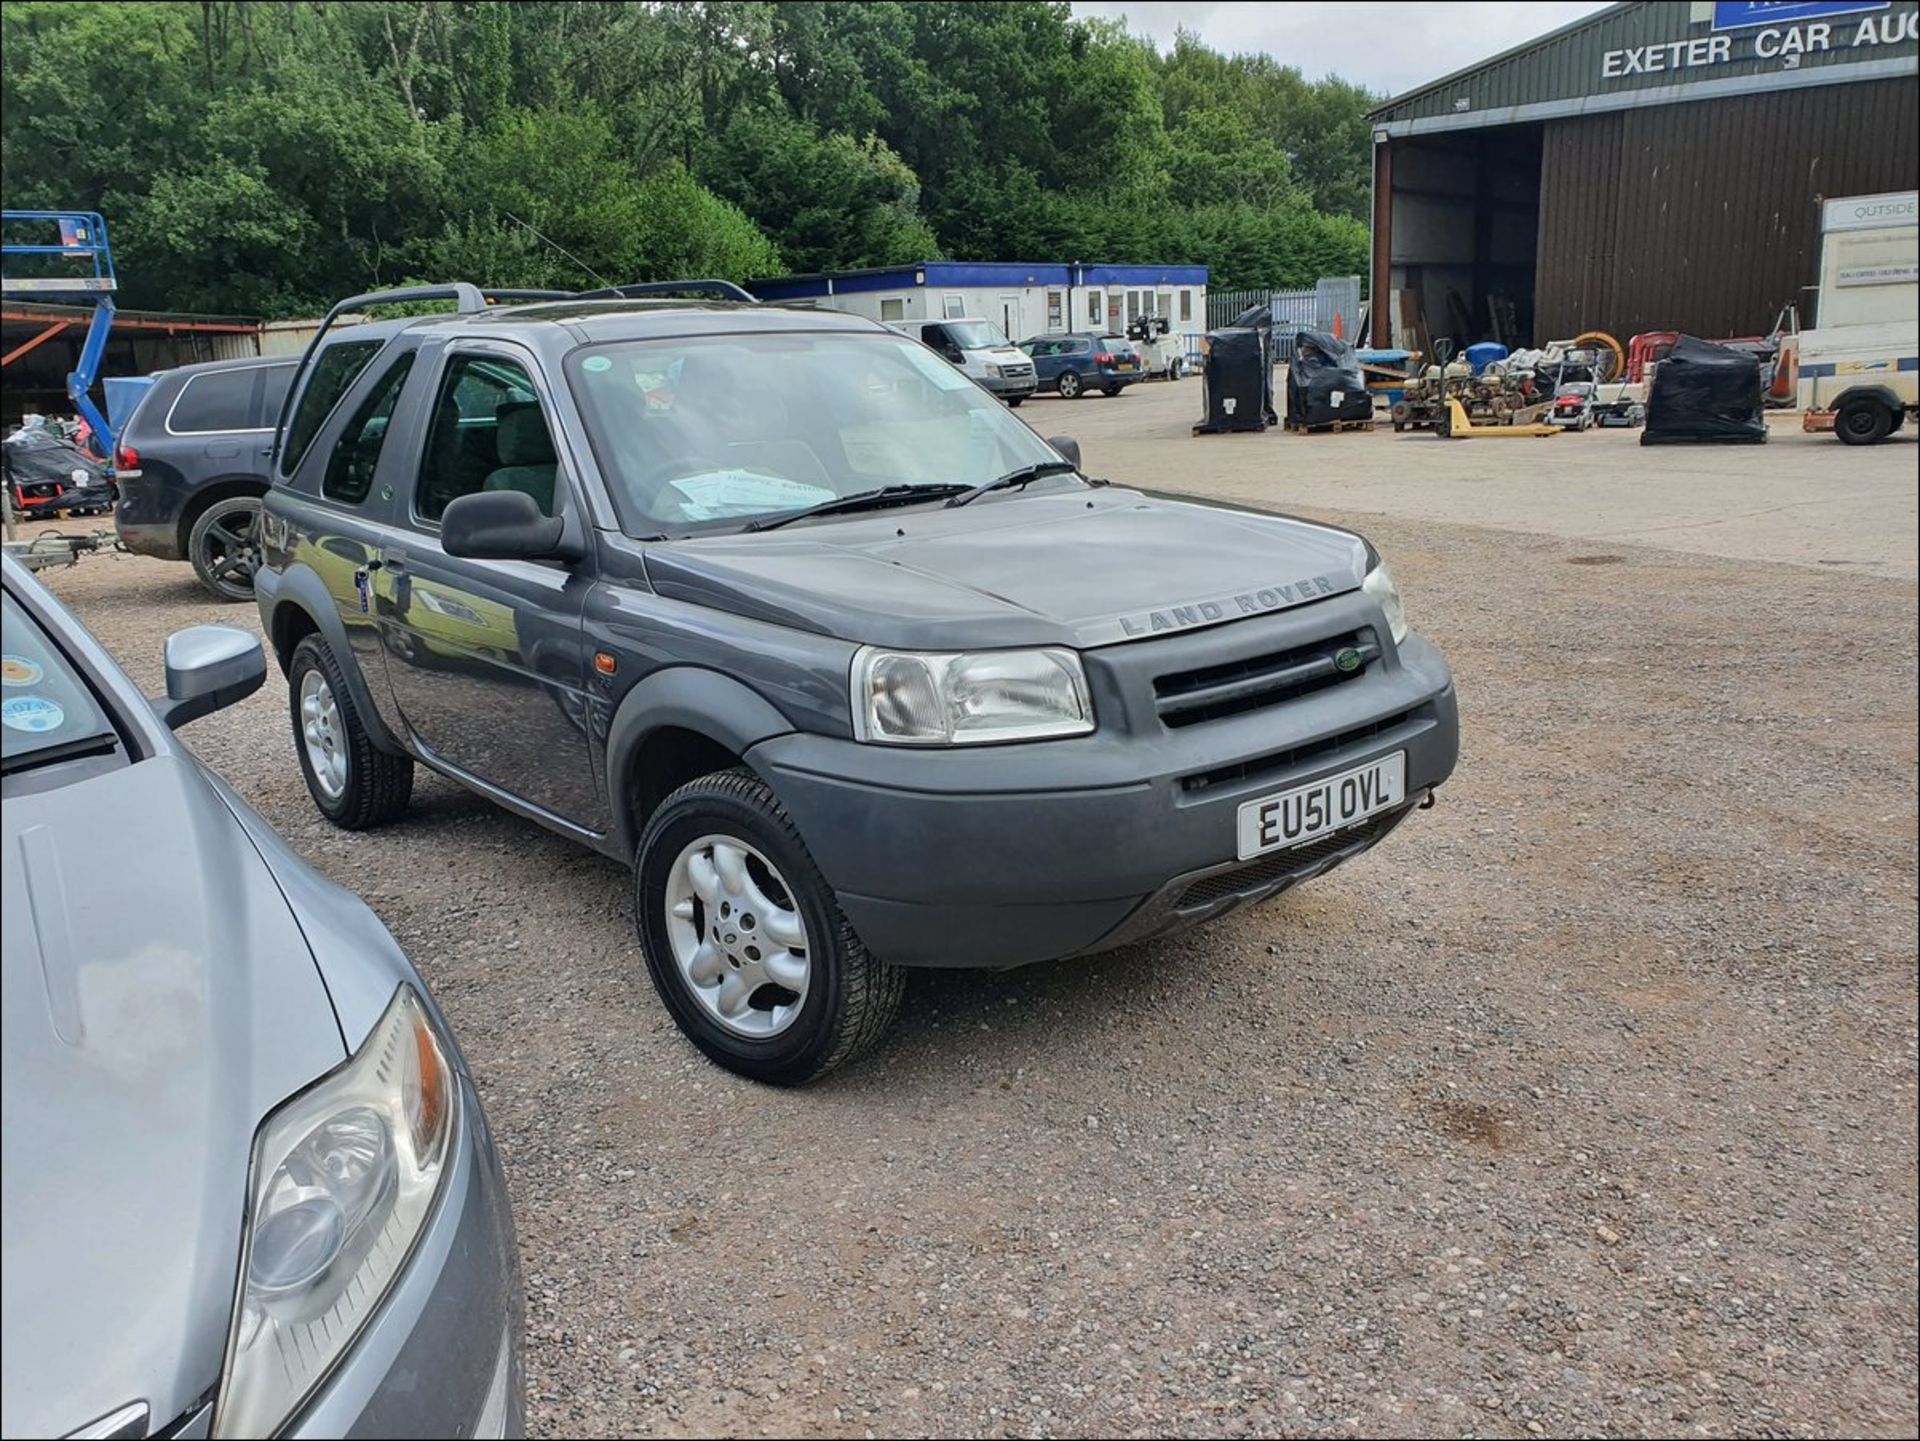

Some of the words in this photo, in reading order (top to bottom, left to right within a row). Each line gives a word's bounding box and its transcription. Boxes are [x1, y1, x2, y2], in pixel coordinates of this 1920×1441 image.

[1602, 36, 1732, 78] EXETER
[1755, 22, 1832, 58] CAR
[1854, 202, 1915, 218] OUTSIDE
[1119, 602, 1223, 636] LAND
[1234, 576, 1335, 613] ROVER
[1259, 785, 1332, 848] EU51
[1340, 767, 1390, 820] OVL
